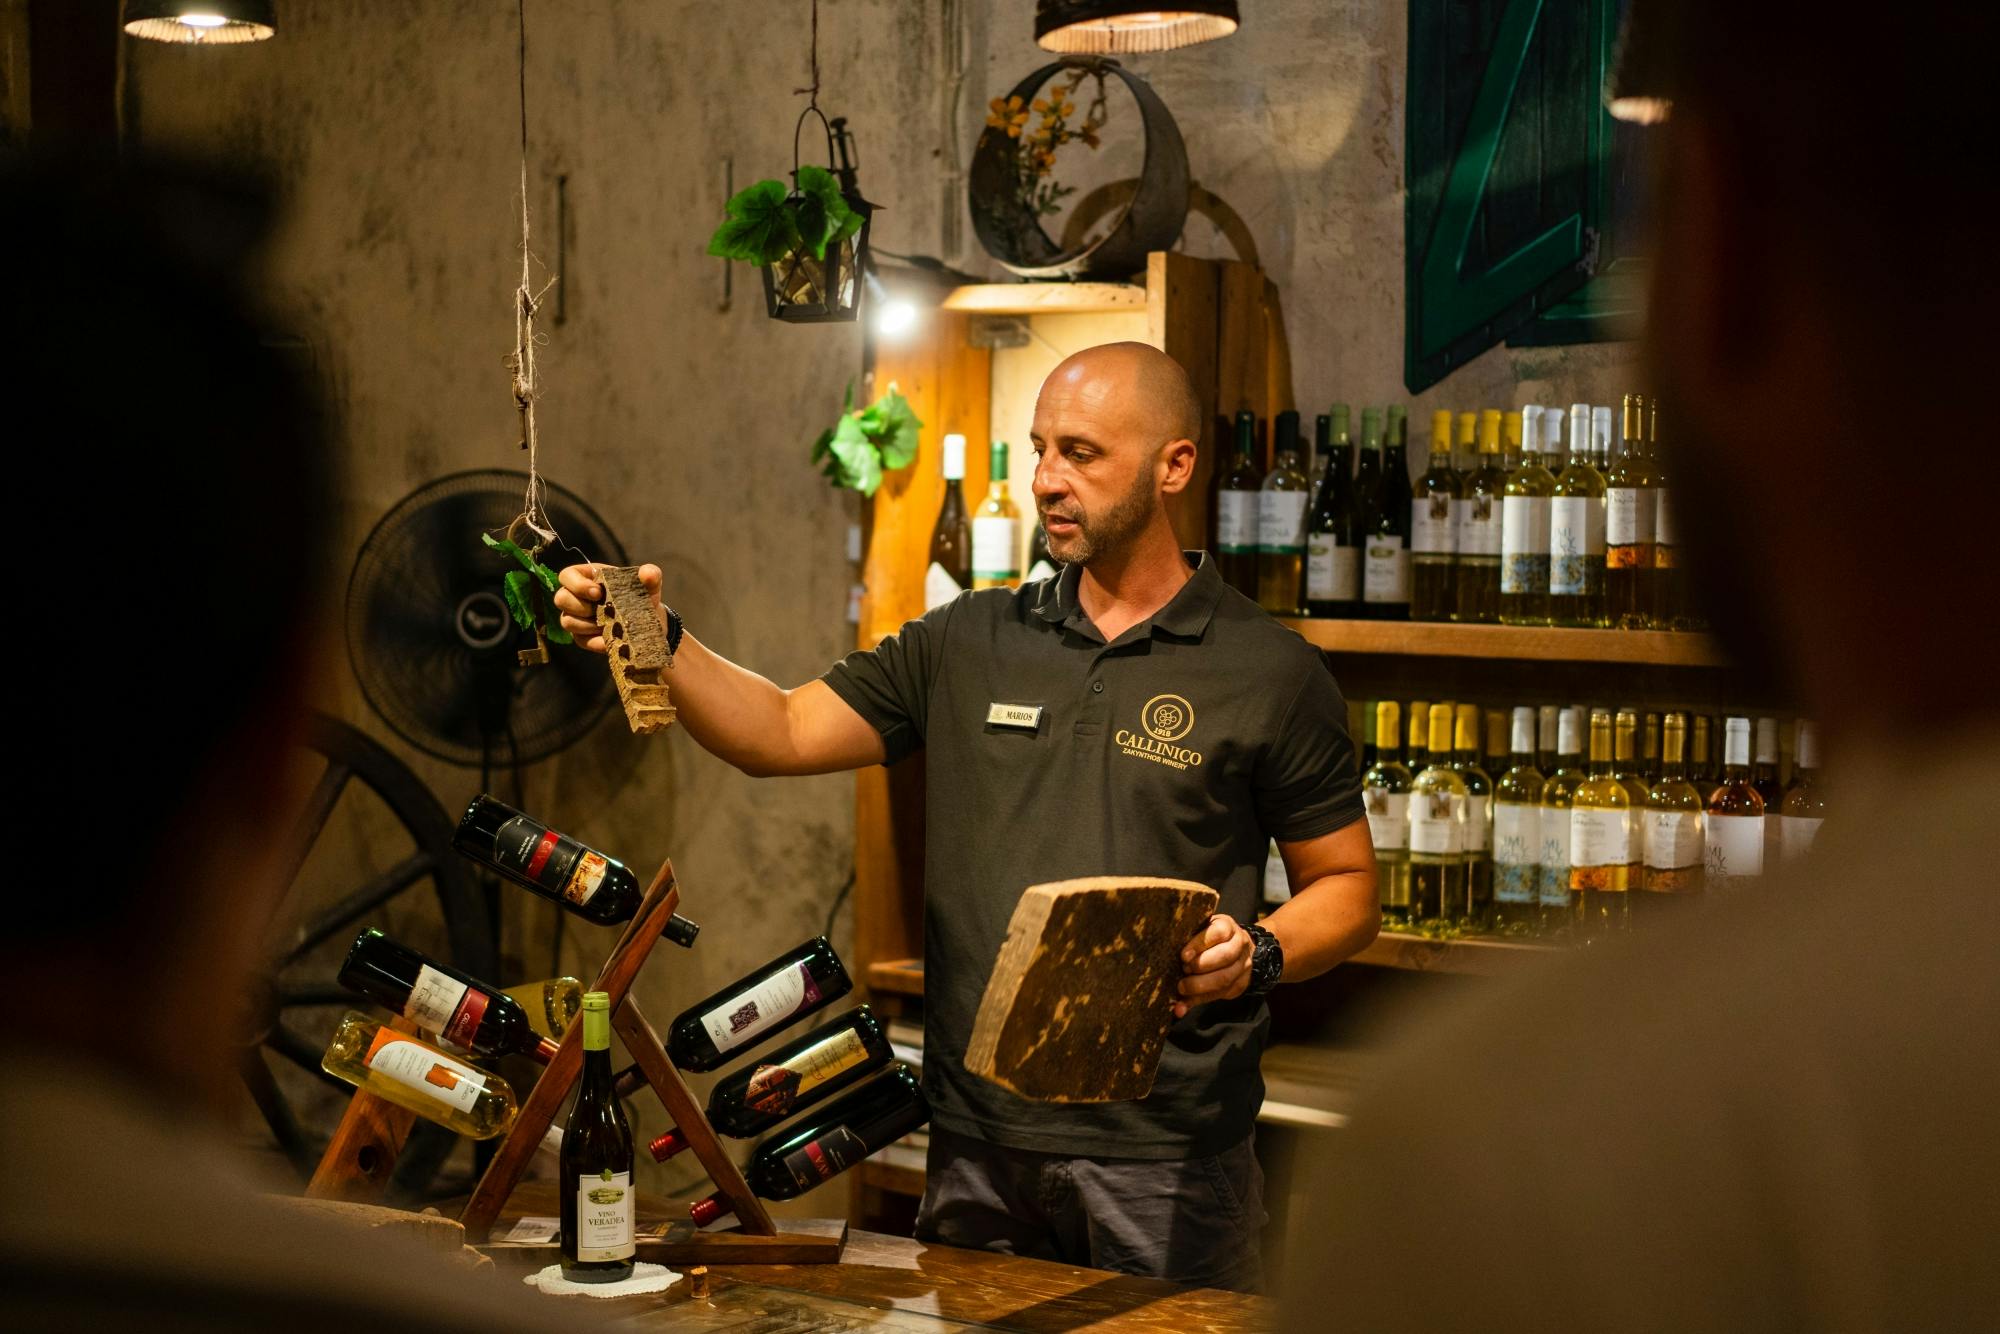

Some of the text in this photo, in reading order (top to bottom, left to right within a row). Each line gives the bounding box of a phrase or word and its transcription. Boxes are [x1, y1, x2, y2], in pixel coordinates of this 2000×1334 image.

[1006, 710, 1033, 721] MARIOS
[1153, 727, 1171, 737] 1918
[1115, 730, 1202, 766] CALLINICO
[1122, 747, 1188, 770] ZAKYNTHOS WINERY
[598, 1210, 616, 1218] VINO
[588, 1216, 625, 1226] VERADEA
